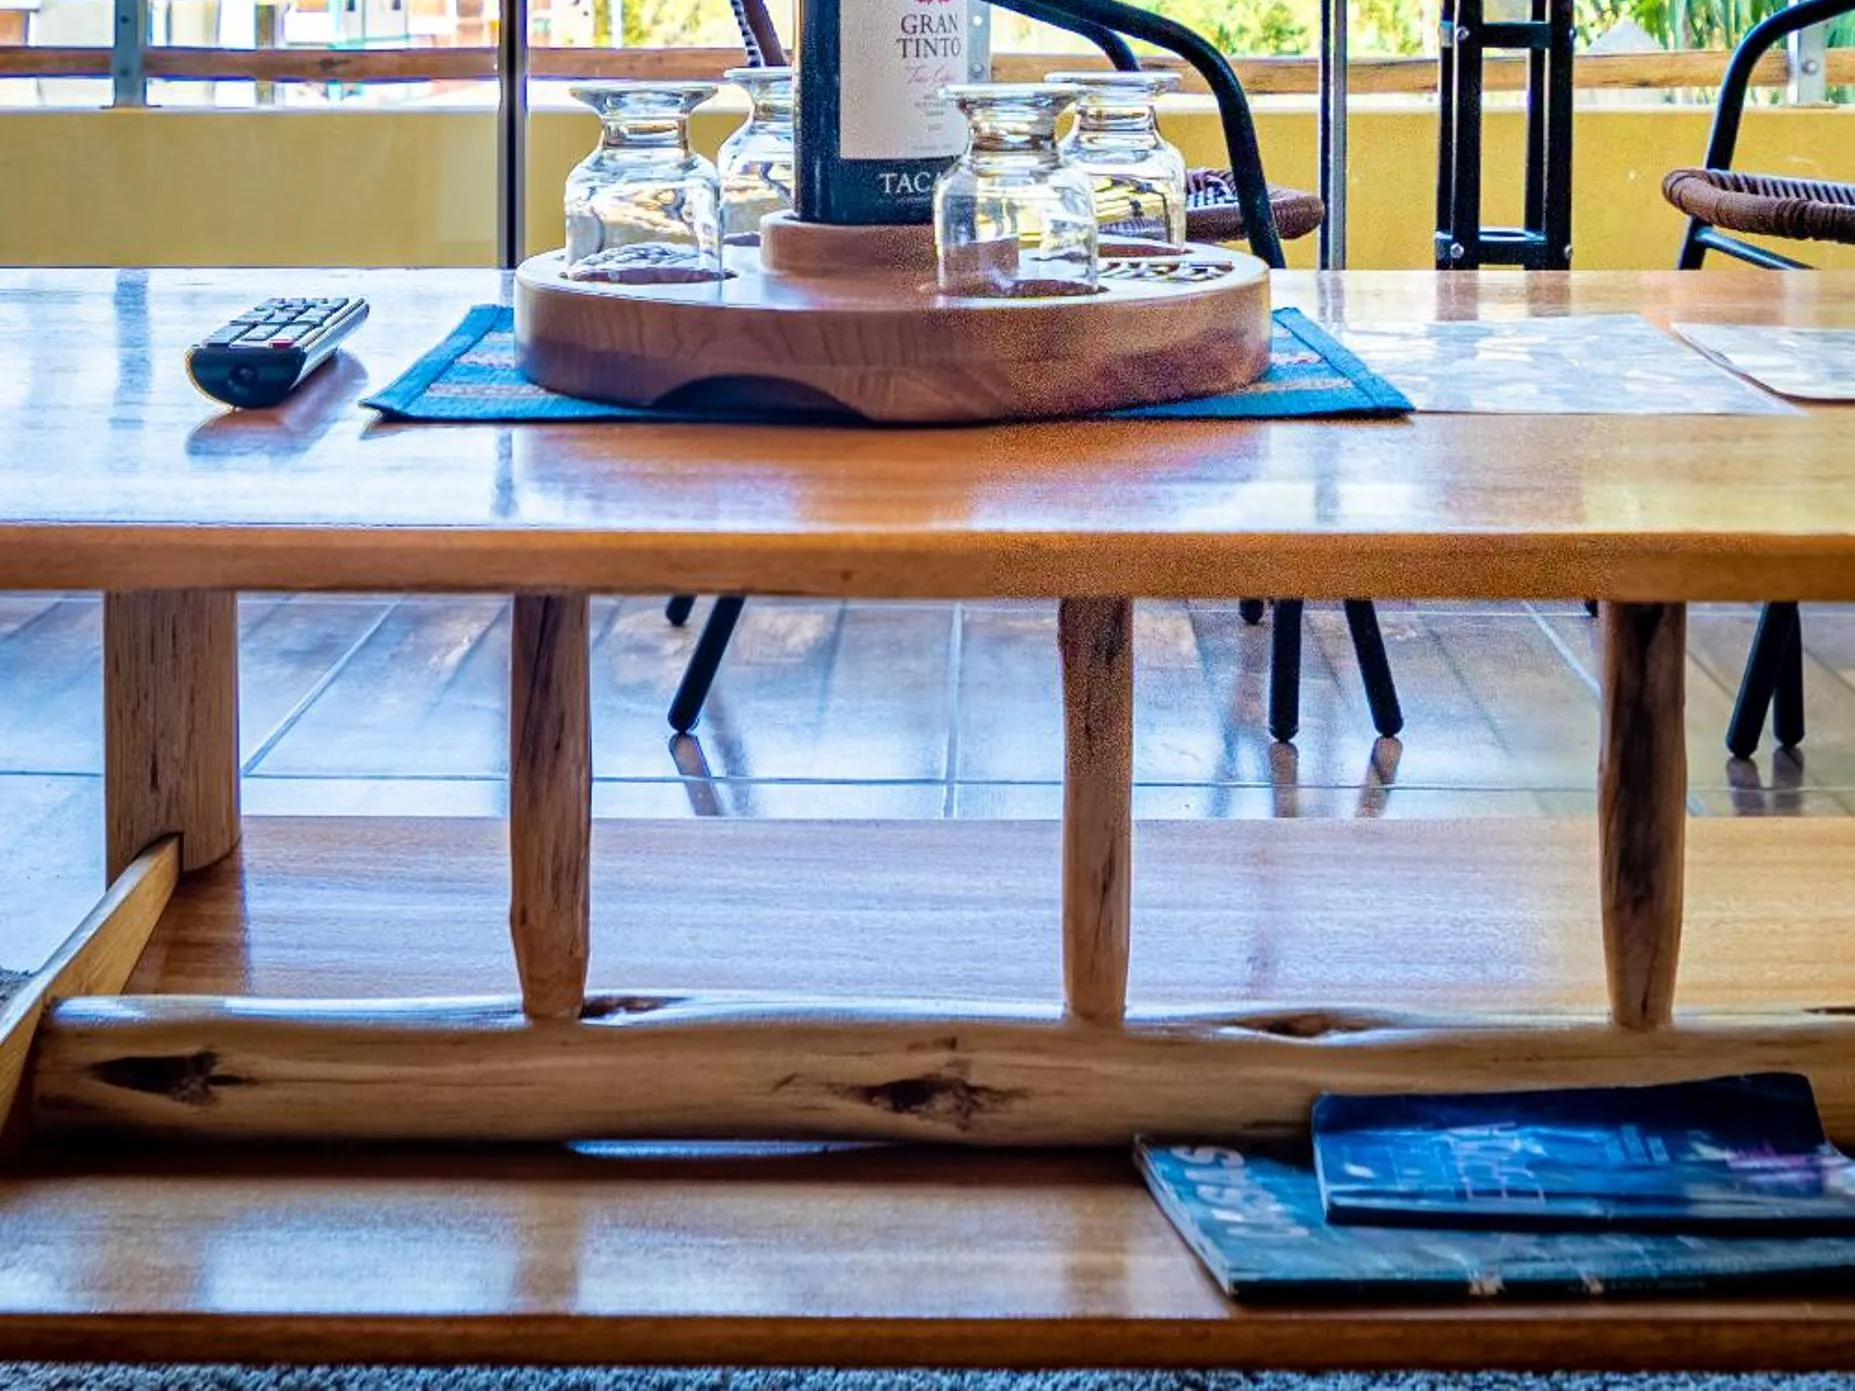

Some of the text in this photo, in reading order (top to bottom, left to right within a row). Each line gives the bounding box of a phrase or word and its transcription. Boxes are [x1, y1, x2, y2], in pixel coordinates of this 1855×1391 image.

[900, 13, 959, 36] GRAN
[896, 37, 962, 60] TINTO
[878, 171, 942, 194] TAC
